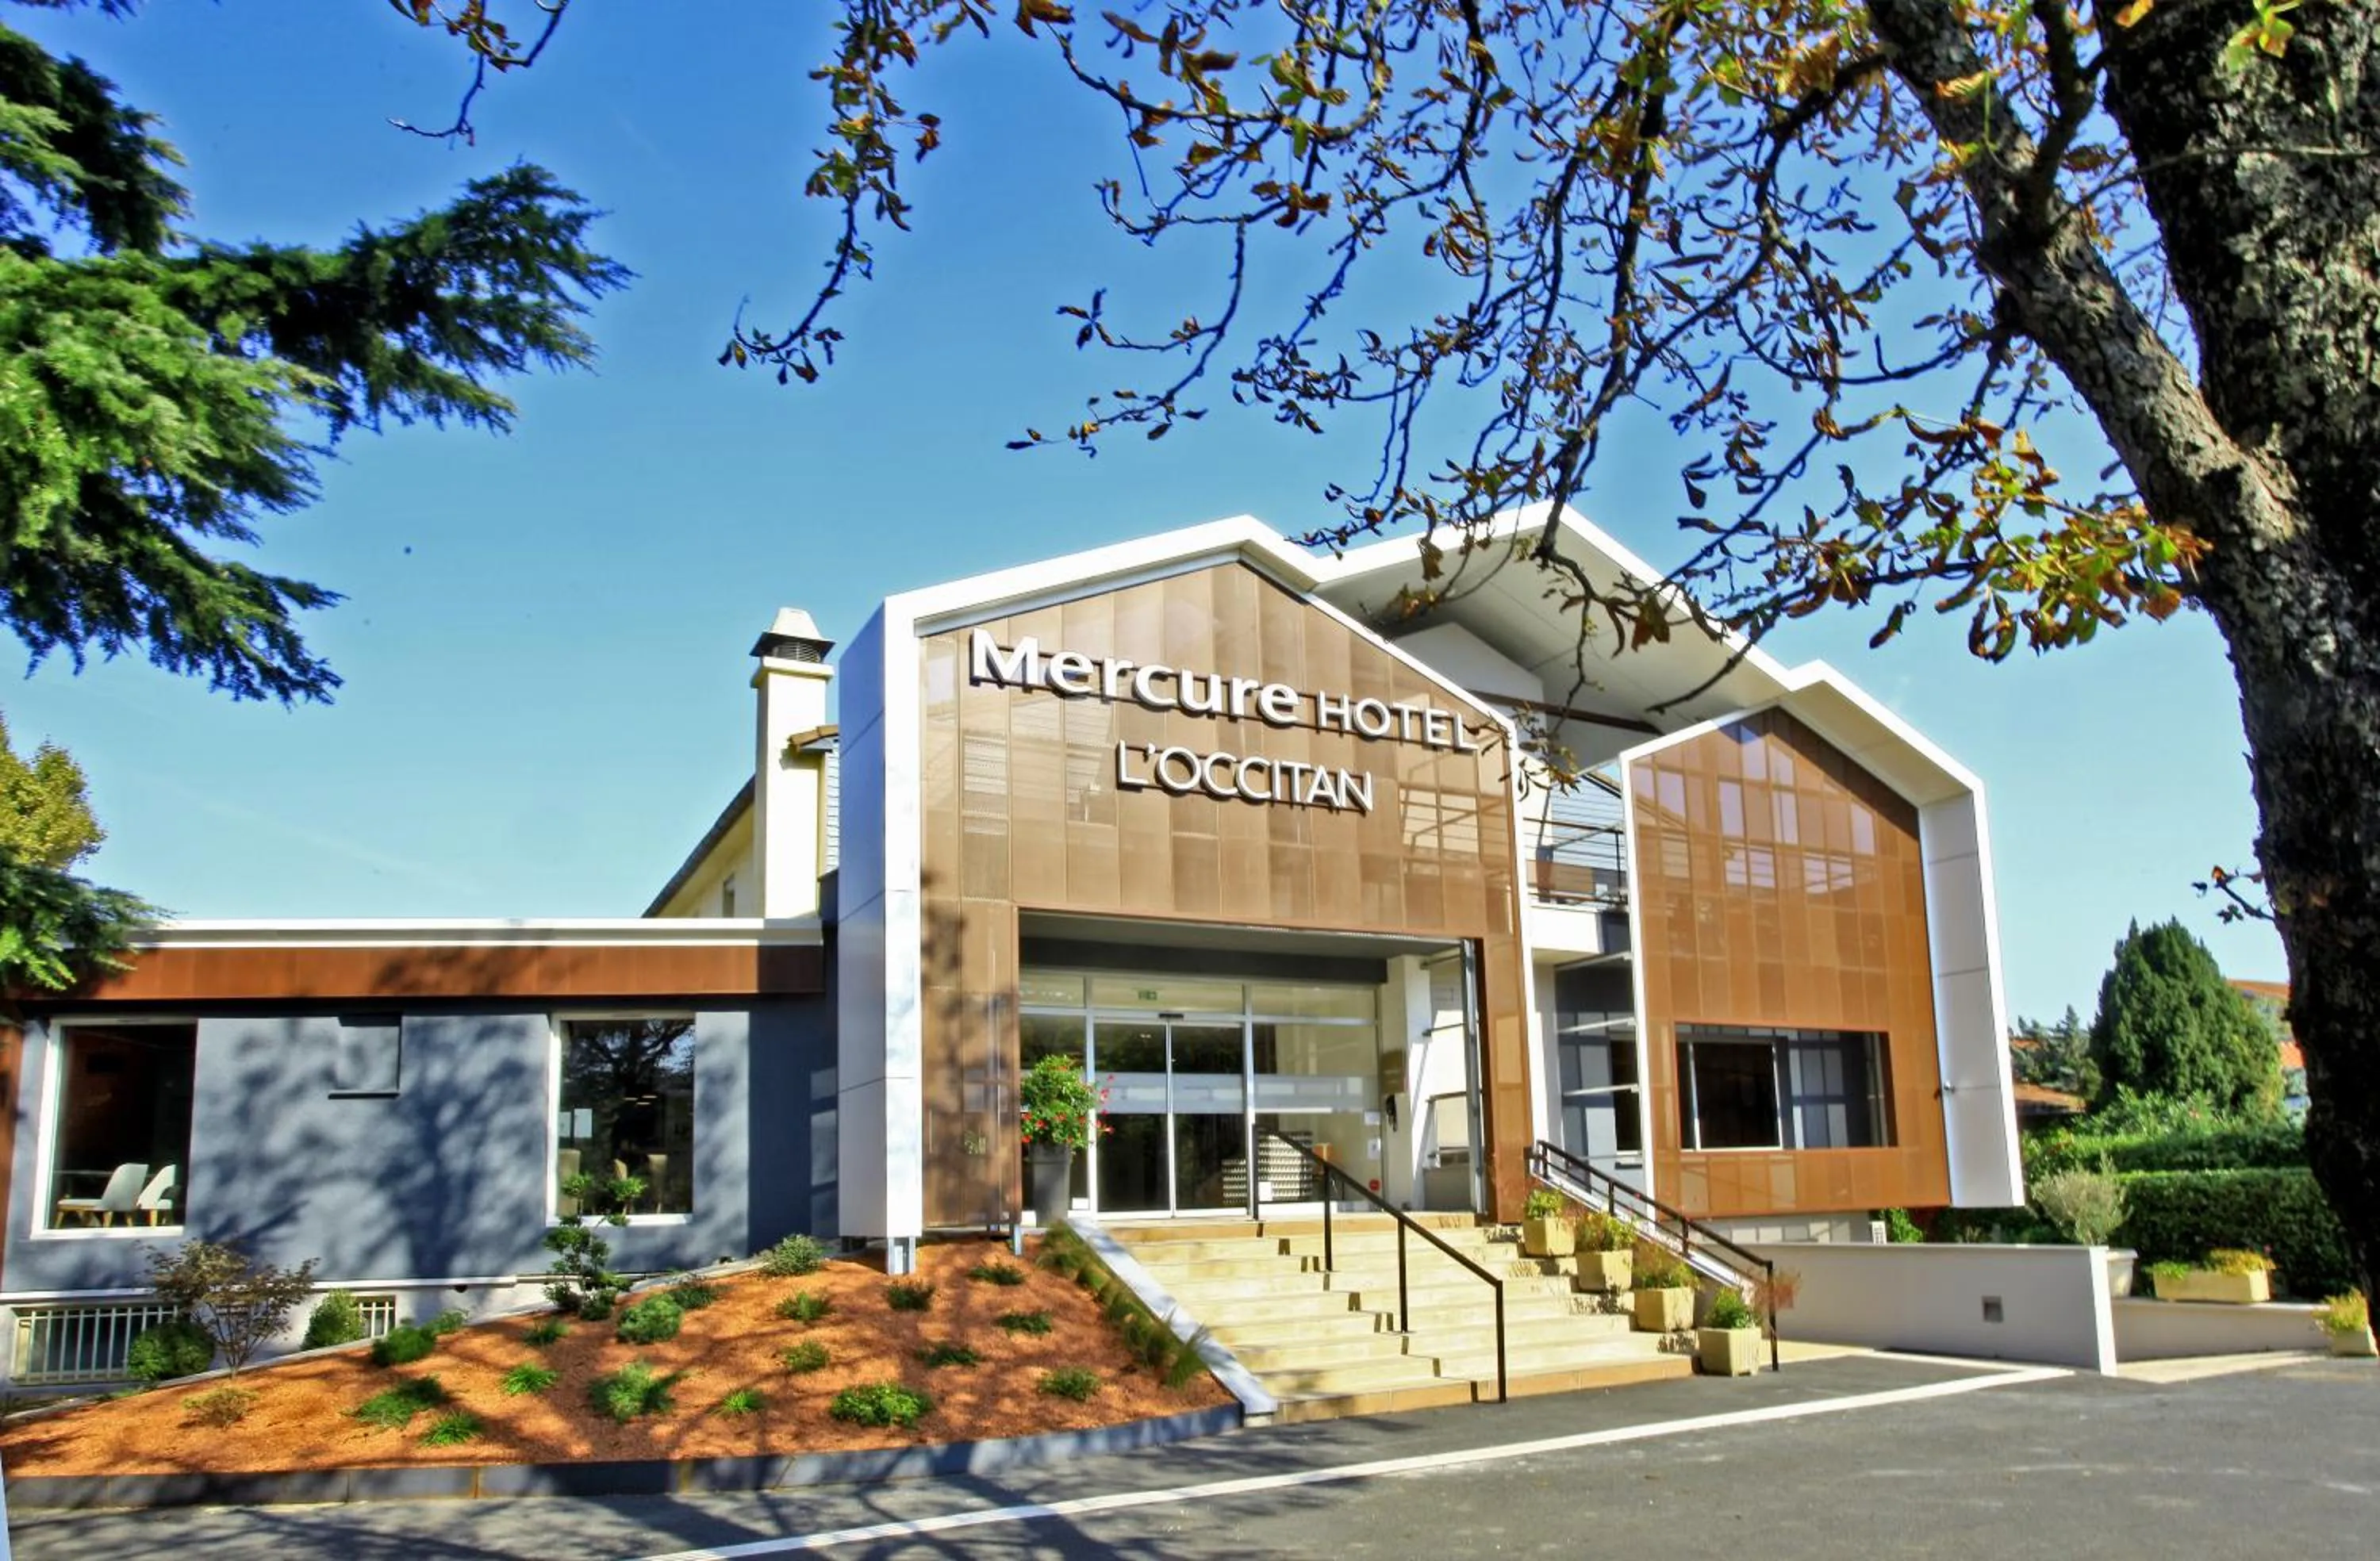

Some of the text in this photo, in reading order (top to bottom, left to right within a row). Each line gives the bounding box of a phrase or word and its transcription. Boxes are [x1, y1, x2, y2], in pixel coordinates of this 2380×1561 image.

[972, 627, 1480, 750] Mercure HOTEL
[1118, 738, 1374, 812] L'OCCITAN
